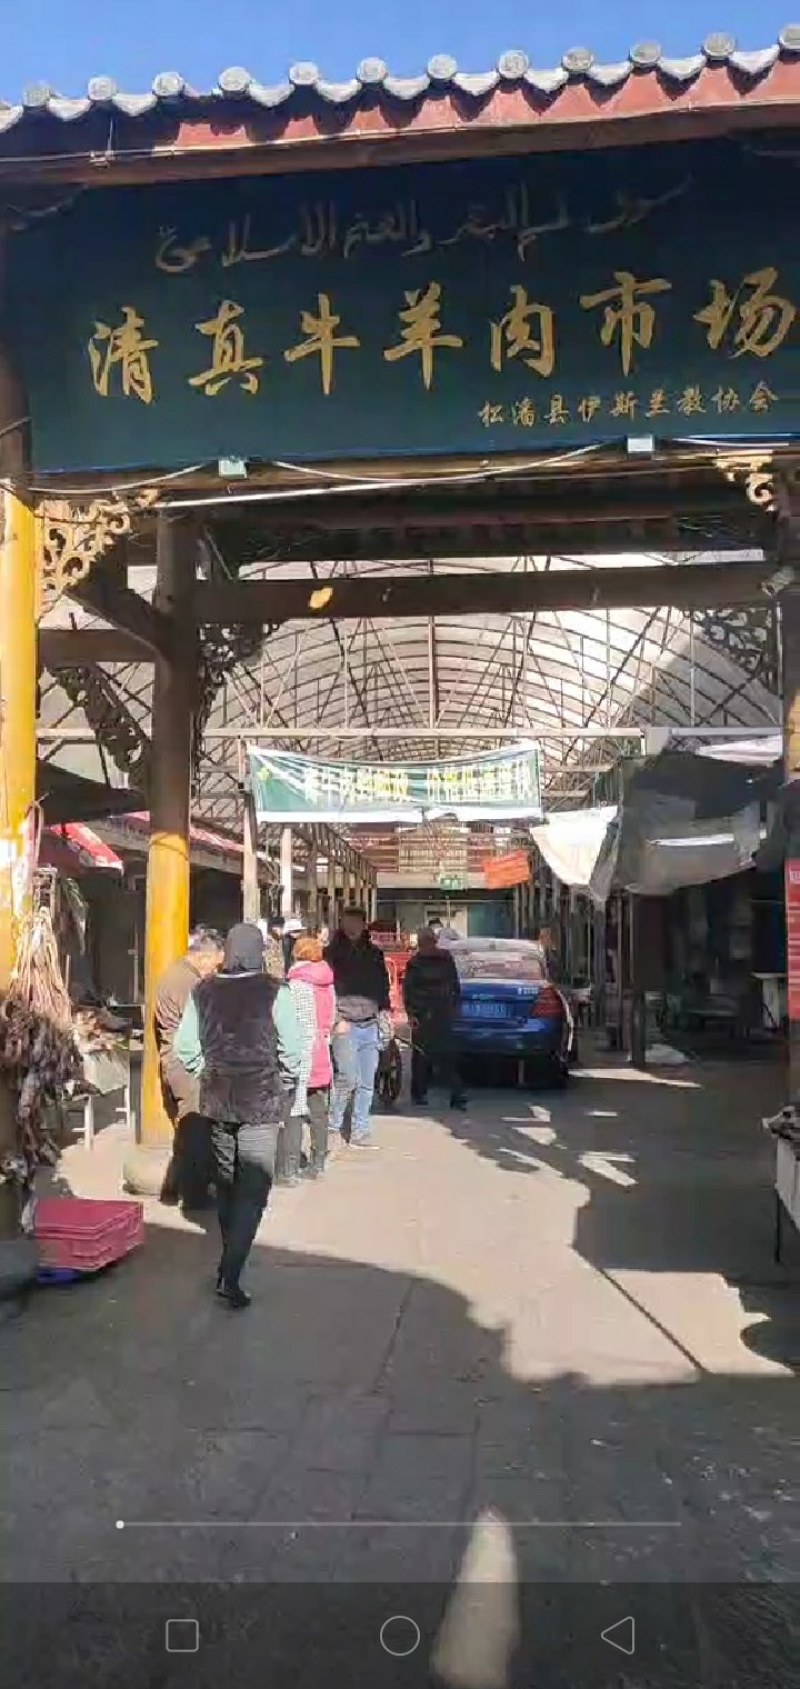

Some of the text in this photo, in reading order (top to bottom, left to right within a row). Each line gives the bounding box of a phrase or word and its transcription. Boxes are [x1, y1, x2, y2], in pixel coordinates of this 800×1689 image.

[88, 266, 797, 404] 清真牛羊肉市场
[478, 380, 778, 427] 松潘县伊斯兰教协会
